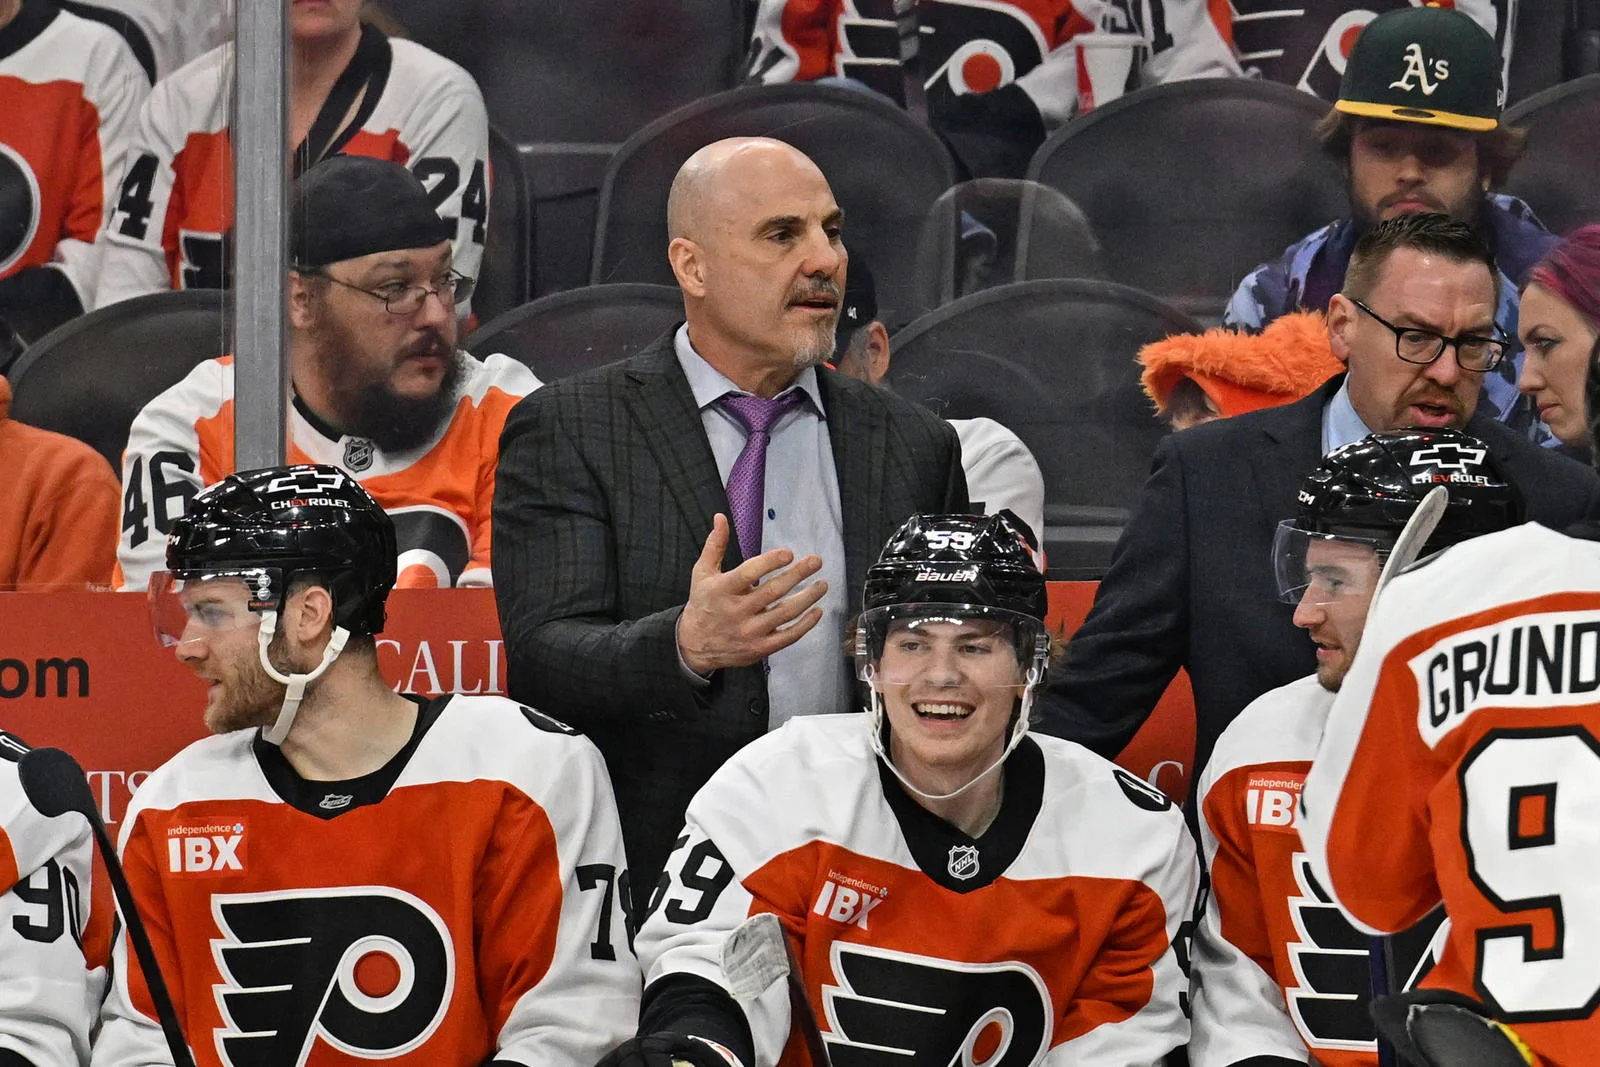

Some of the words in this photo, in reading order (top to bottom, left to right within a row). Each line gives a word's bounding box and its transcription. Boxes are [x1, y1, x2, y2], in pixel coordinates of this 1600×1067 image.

[1388, 43, 1449, 96] A's
[107, 153, 160, 241] 4
[412, 157, 487, 244] 24
[122, 451, 199, 550] 46
[1412, 473, 1488, 486] CHEVROLET
[271, 498, 349, 510] CHEVROLET
[925, 530, 974, 550] 59
[1428, 621, 1600, 728] GRUND
[167, 824, 231, 836] Independence
[168, 835, 244, 872] IBX
[954, 854, 973, 873] NHL
[1457, 724, 1600, 1024] 9
[828, 869, 880, 894] Independence
[813, 880, 883, 931] IBX
